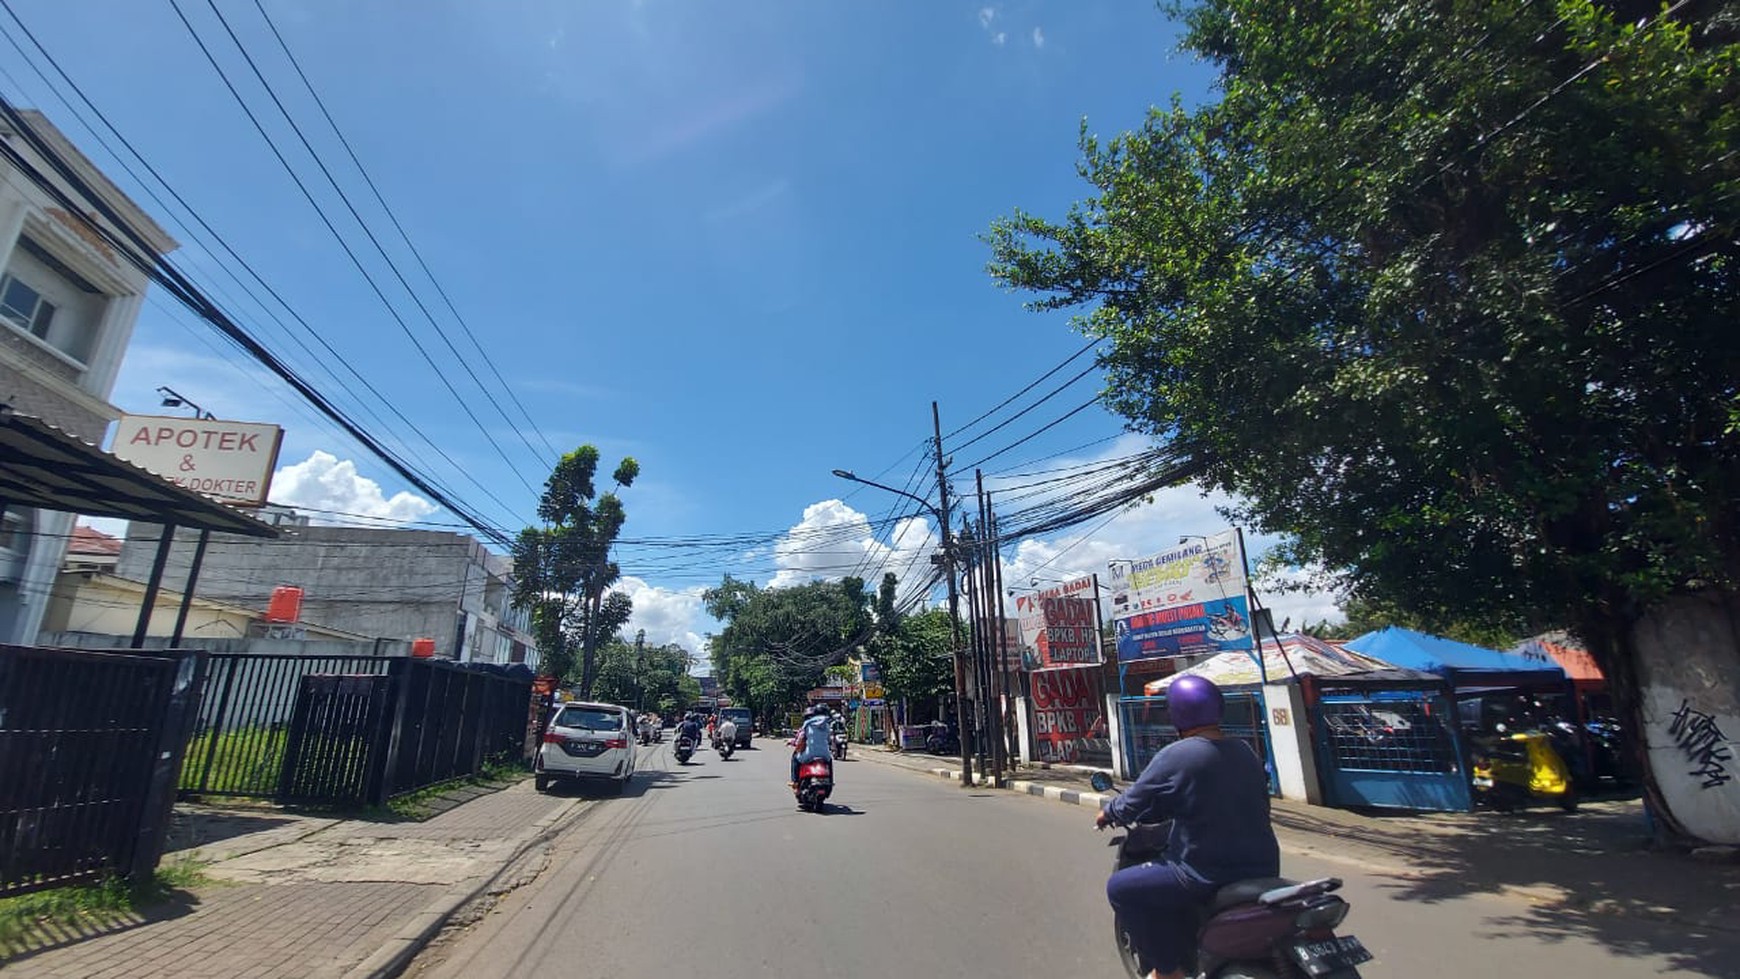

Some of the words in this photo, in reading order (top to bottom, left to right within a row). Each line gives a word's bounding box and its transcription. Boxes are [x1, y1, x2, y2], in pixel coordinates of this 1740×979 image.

[130, 426, 261, 452] APOTEK
[179, 454, 196, 472] &
[190, 478, 257, 493] DOKTER
[1044, 599, 1094, 628] GADAI
[1080, 627, 1095, 643] HP
[1054, 646, 1091, 661] LAPTOP
[1272, 708, 1287, 726] 68
